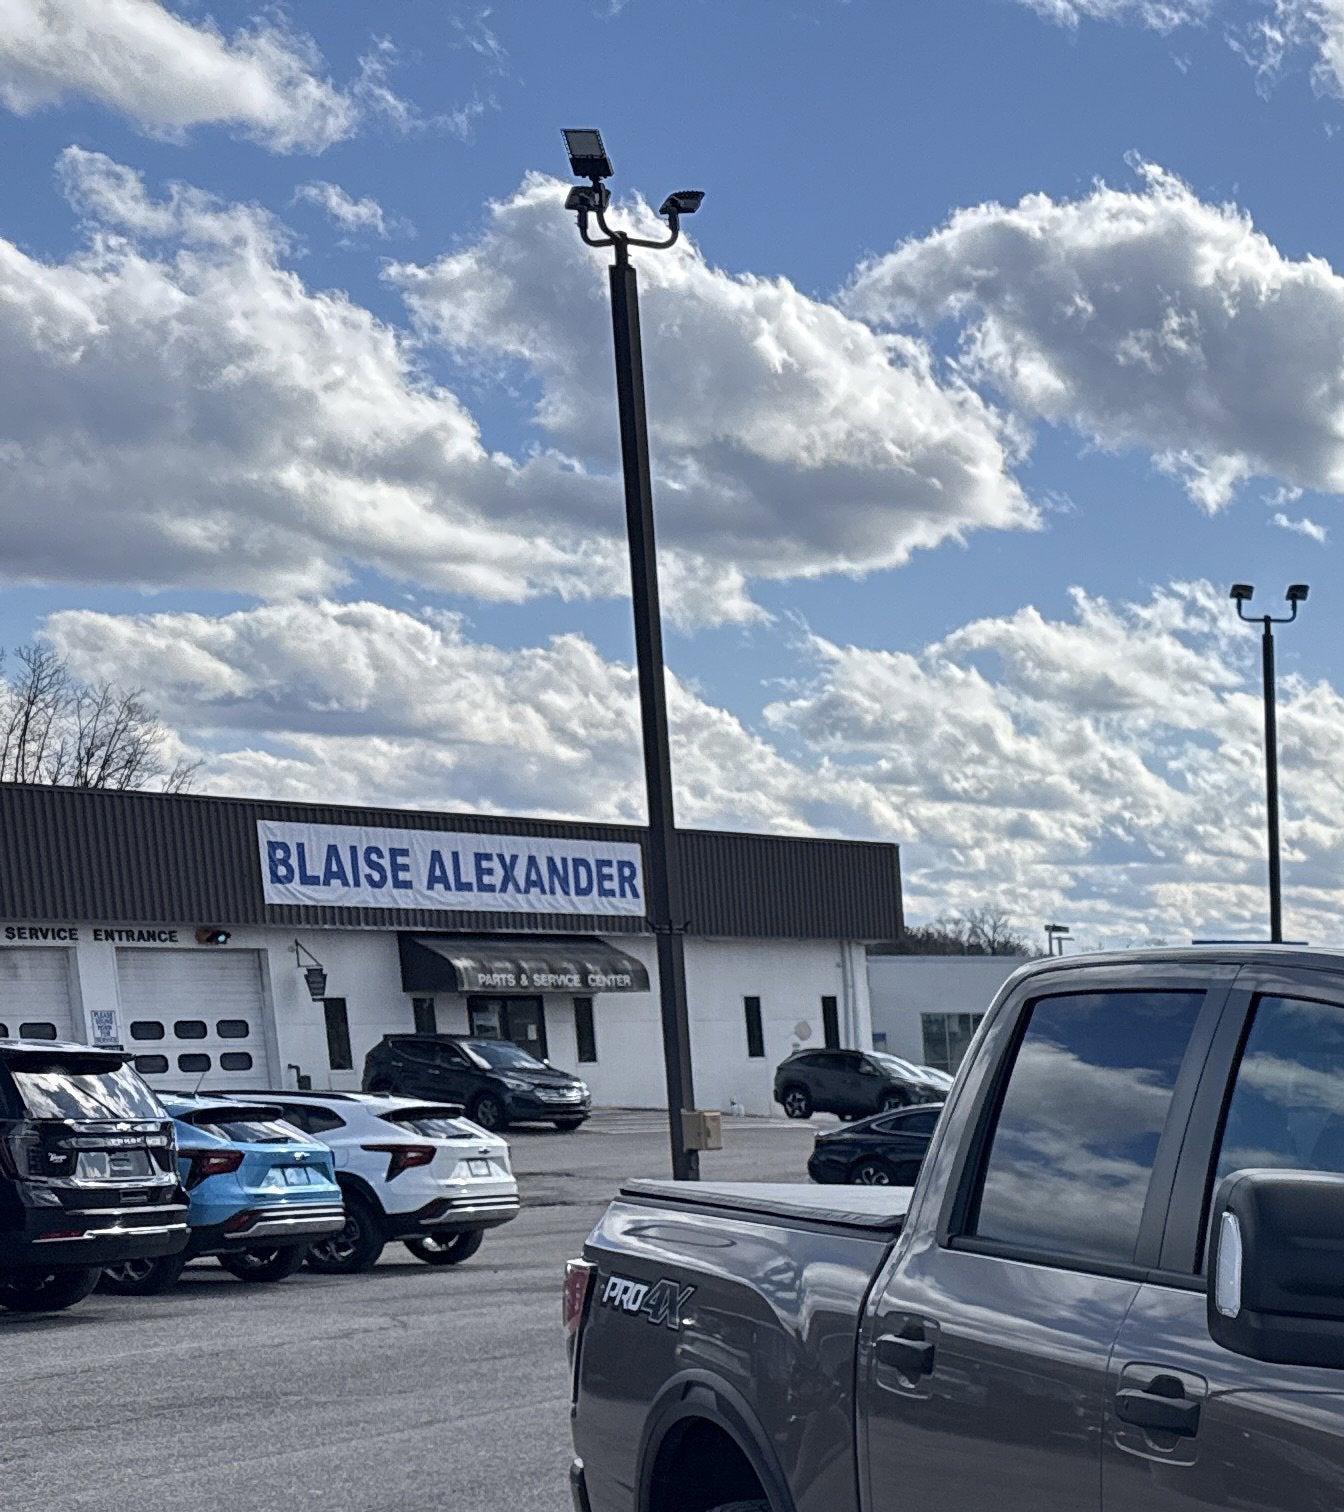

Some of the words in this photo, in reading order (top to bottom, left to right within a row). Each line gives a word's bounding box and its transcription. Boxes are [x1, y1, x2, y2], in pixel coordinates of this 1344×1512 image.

[266, 840, 413, 890] BLAISE
[426, 849, 641, 899] ALEXANDER
[4, 926, 79, 941] SERVICE
[93, 928, 179, 943] ENTRANCE
[477, 973, 516, 987] PARTS
[520, 974, 529, 987] &
[532, 973, 582, 987] SERVICE
[587, 973, 632, 987] CENTER
